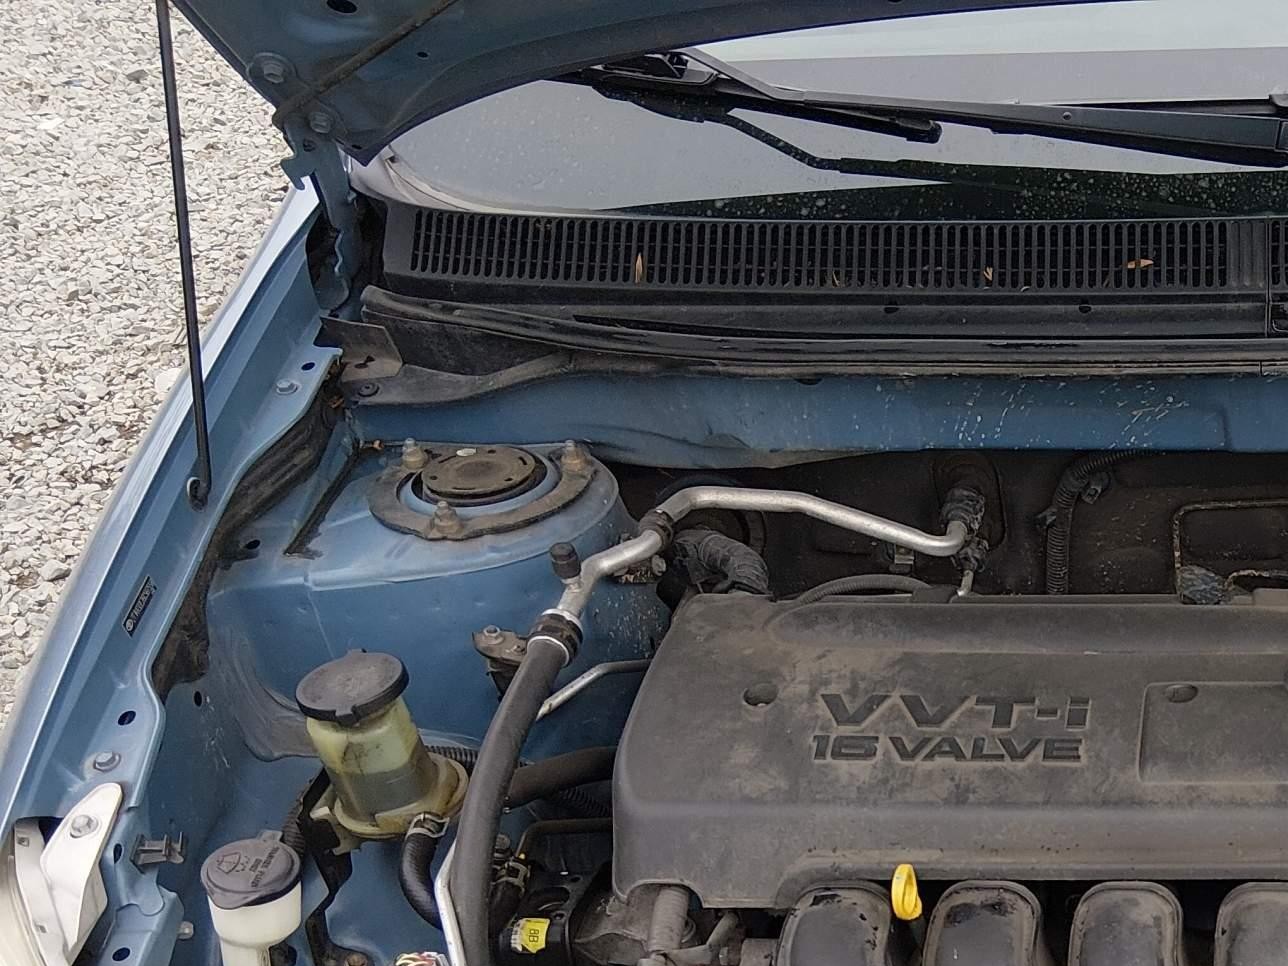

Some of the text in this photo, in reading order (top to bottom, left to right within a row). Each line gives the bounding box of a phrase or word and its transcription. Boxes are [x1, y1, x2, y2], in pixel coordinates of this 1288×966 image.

[820, 693, 1090, 729] VVT-i
[812, 735, 1083, 762] 16 VALVE
